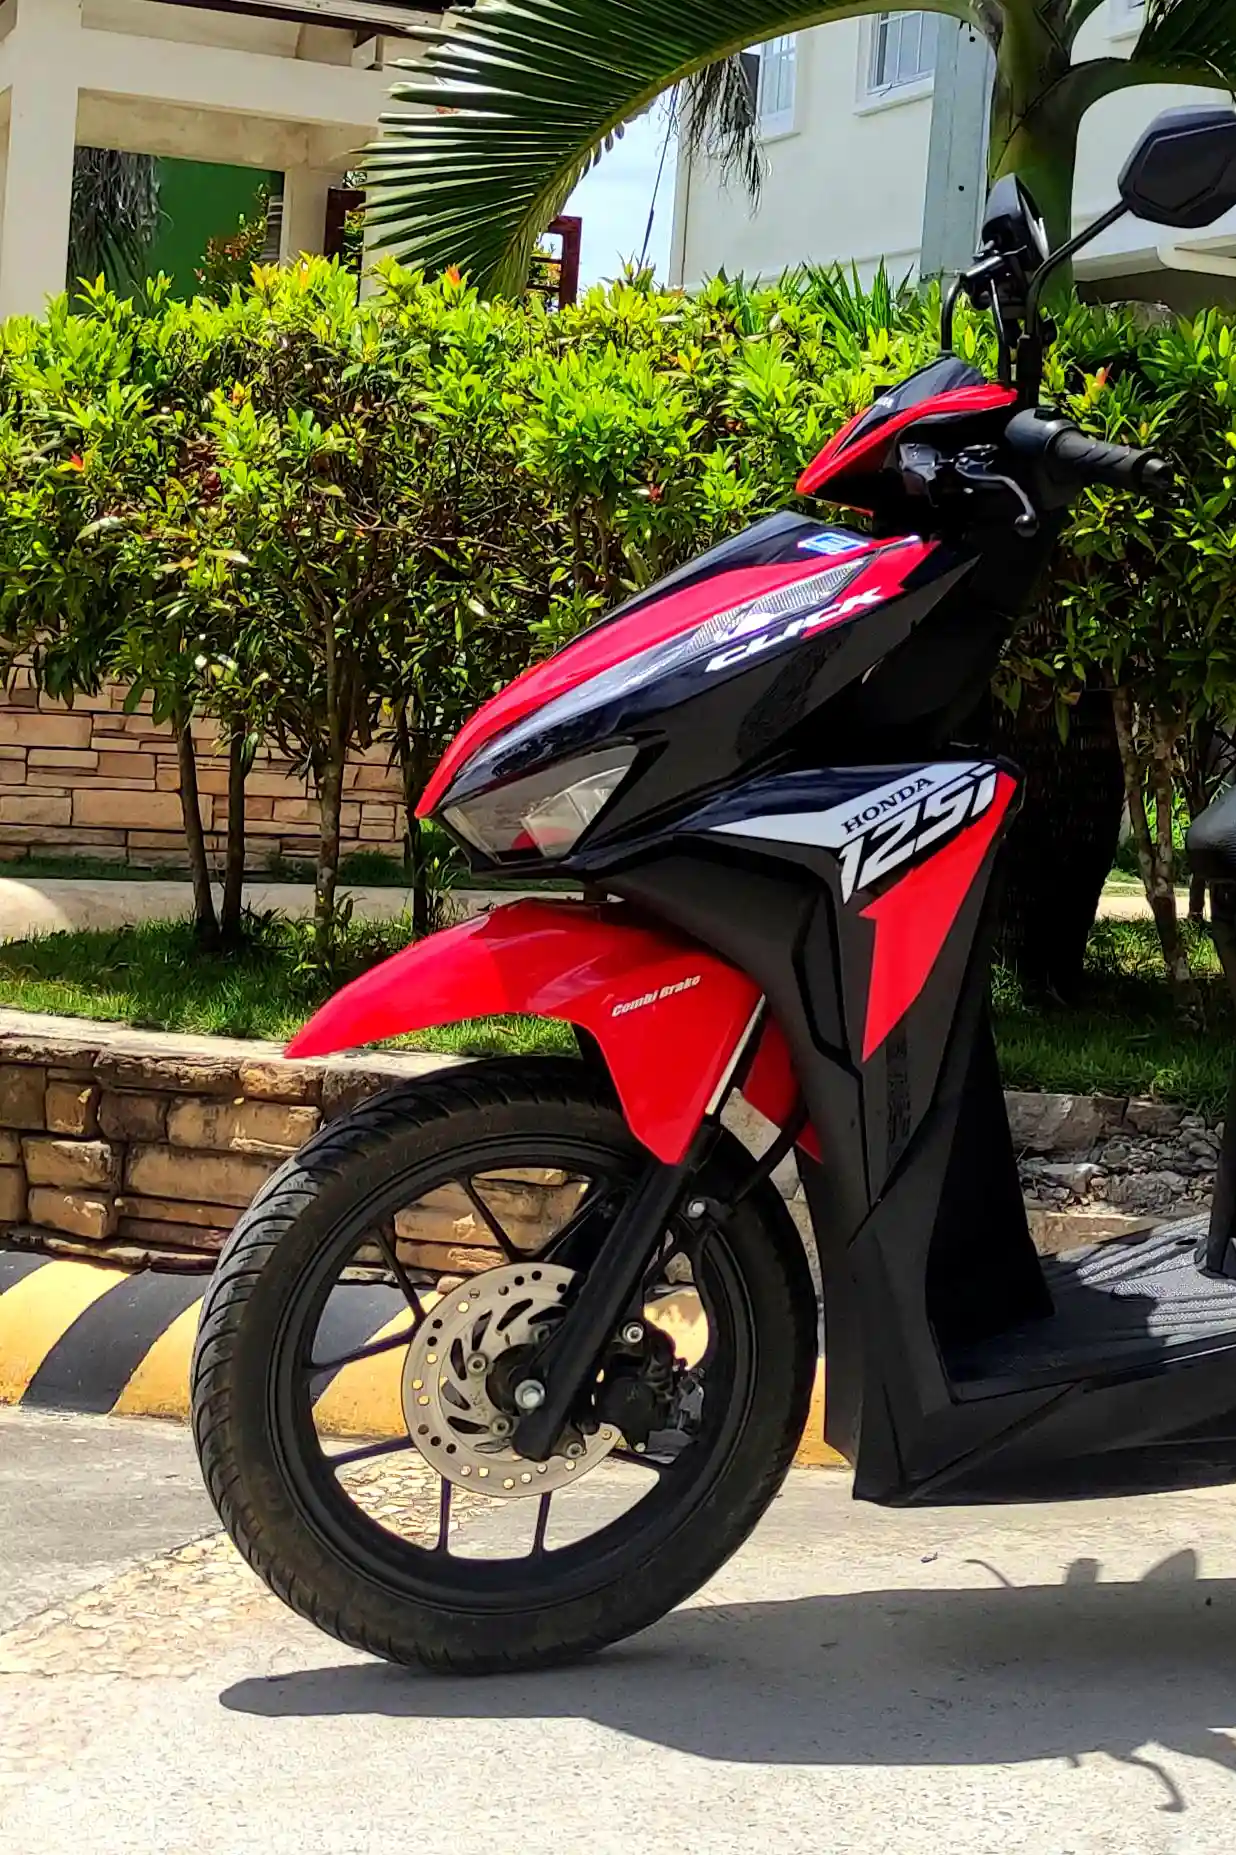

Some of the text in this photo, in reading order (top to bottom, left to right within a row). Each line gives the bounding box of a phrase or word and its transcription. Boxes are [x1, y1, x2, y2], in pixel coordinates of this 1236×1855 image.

[704, 586, 884, 672] CLICK
[841, 776, 935, 834] HONDA
[611, 975, 701, 1017] Combi Brake
